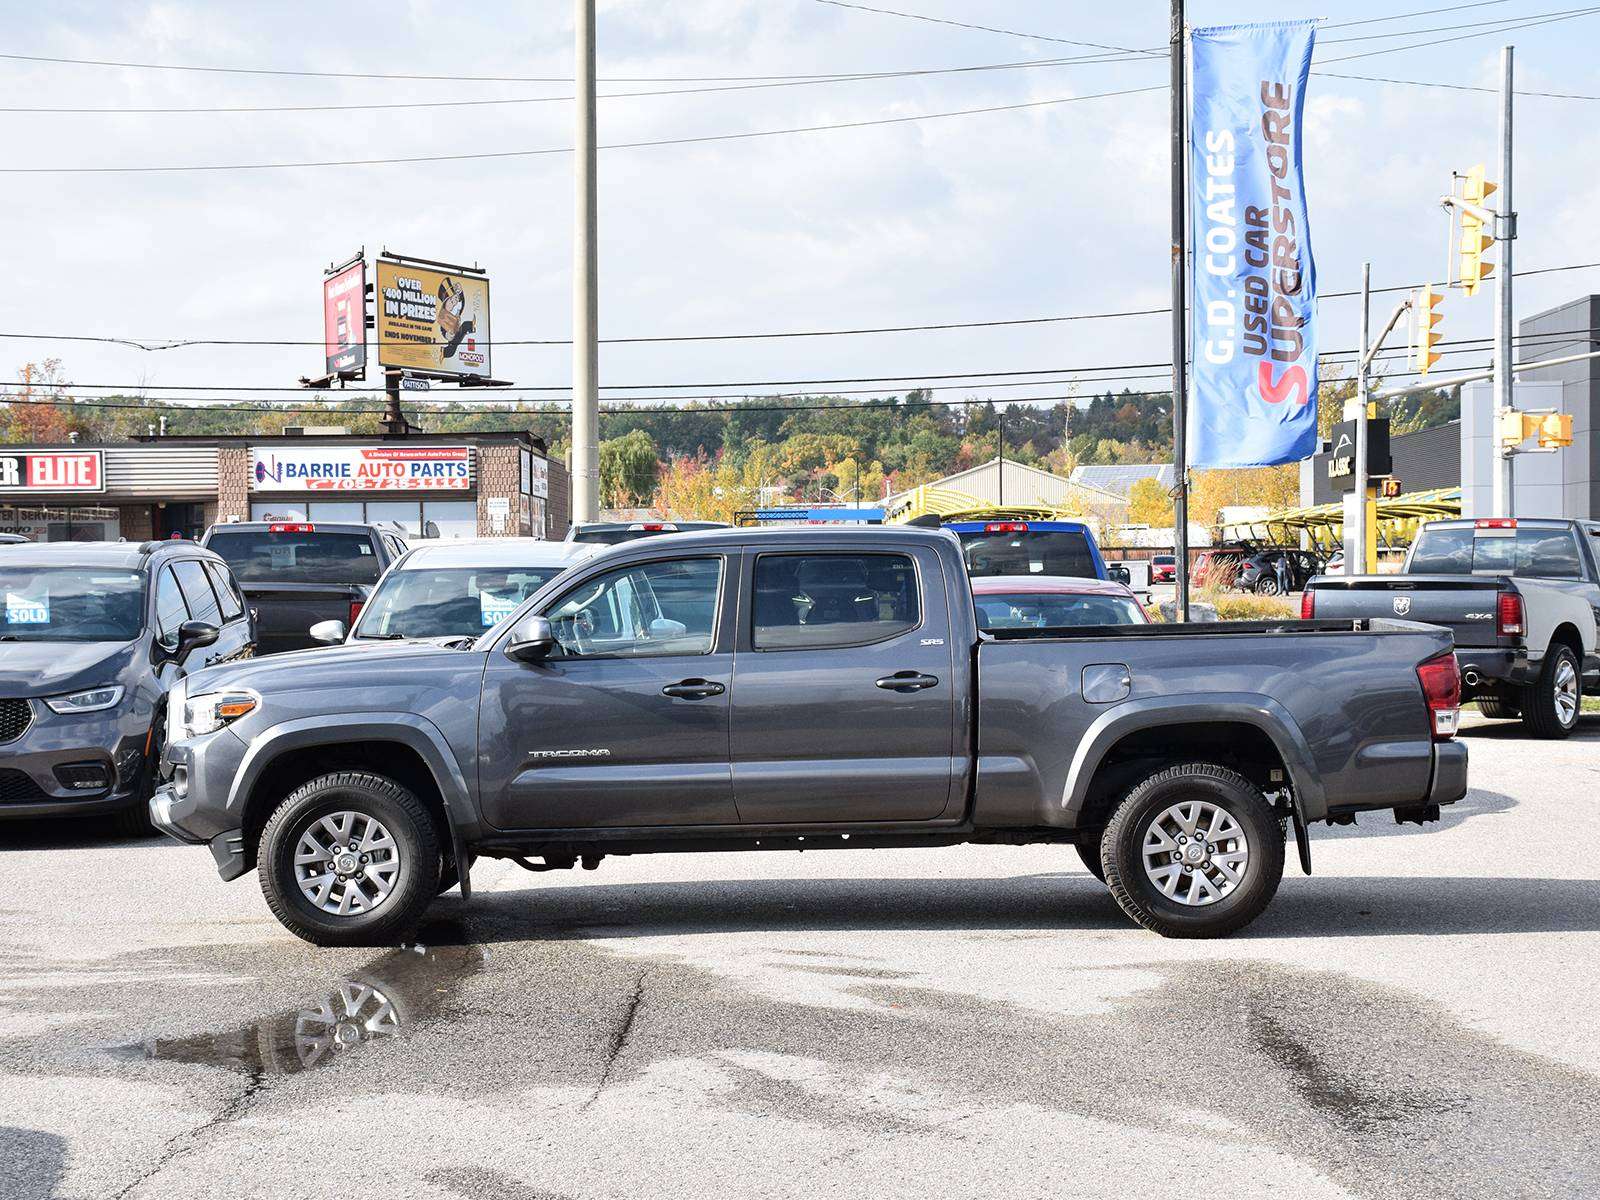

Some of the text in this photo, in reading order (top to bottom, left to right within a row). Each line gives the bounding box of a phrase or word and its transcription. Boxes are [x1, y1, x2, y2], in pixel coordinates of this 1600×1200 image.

[1205, 128, 1235, 364] G.D. COATES
[1258, 80, 1308, 404] SUPERSTORE
[398, 277, 422, 291] OVER
[1244, 205, 1269, 355] USED CAR
[402, 290, 436, 305] MILLION
[386, 300, 436, 321] IN PRIZES
[384, 330, 399, 339] ENDS
[400, 332, 432, 344] NOVEMBER
[459, 352, 484, 363] MONOPOLY
[404, 379, 429, 390] PATTISON
[0, 456, 92, 485] R ELITE
[286, 462, 467, 477] BARRIE AUTO PARTS
[0, 510, 13, 520] ER
[21, 508, 65, 520] SERVICE
[92, 509, 119, 520] SALES
[9, 608, 48, 622] SOLD
[528, 749, 610, 757] TACOMA
